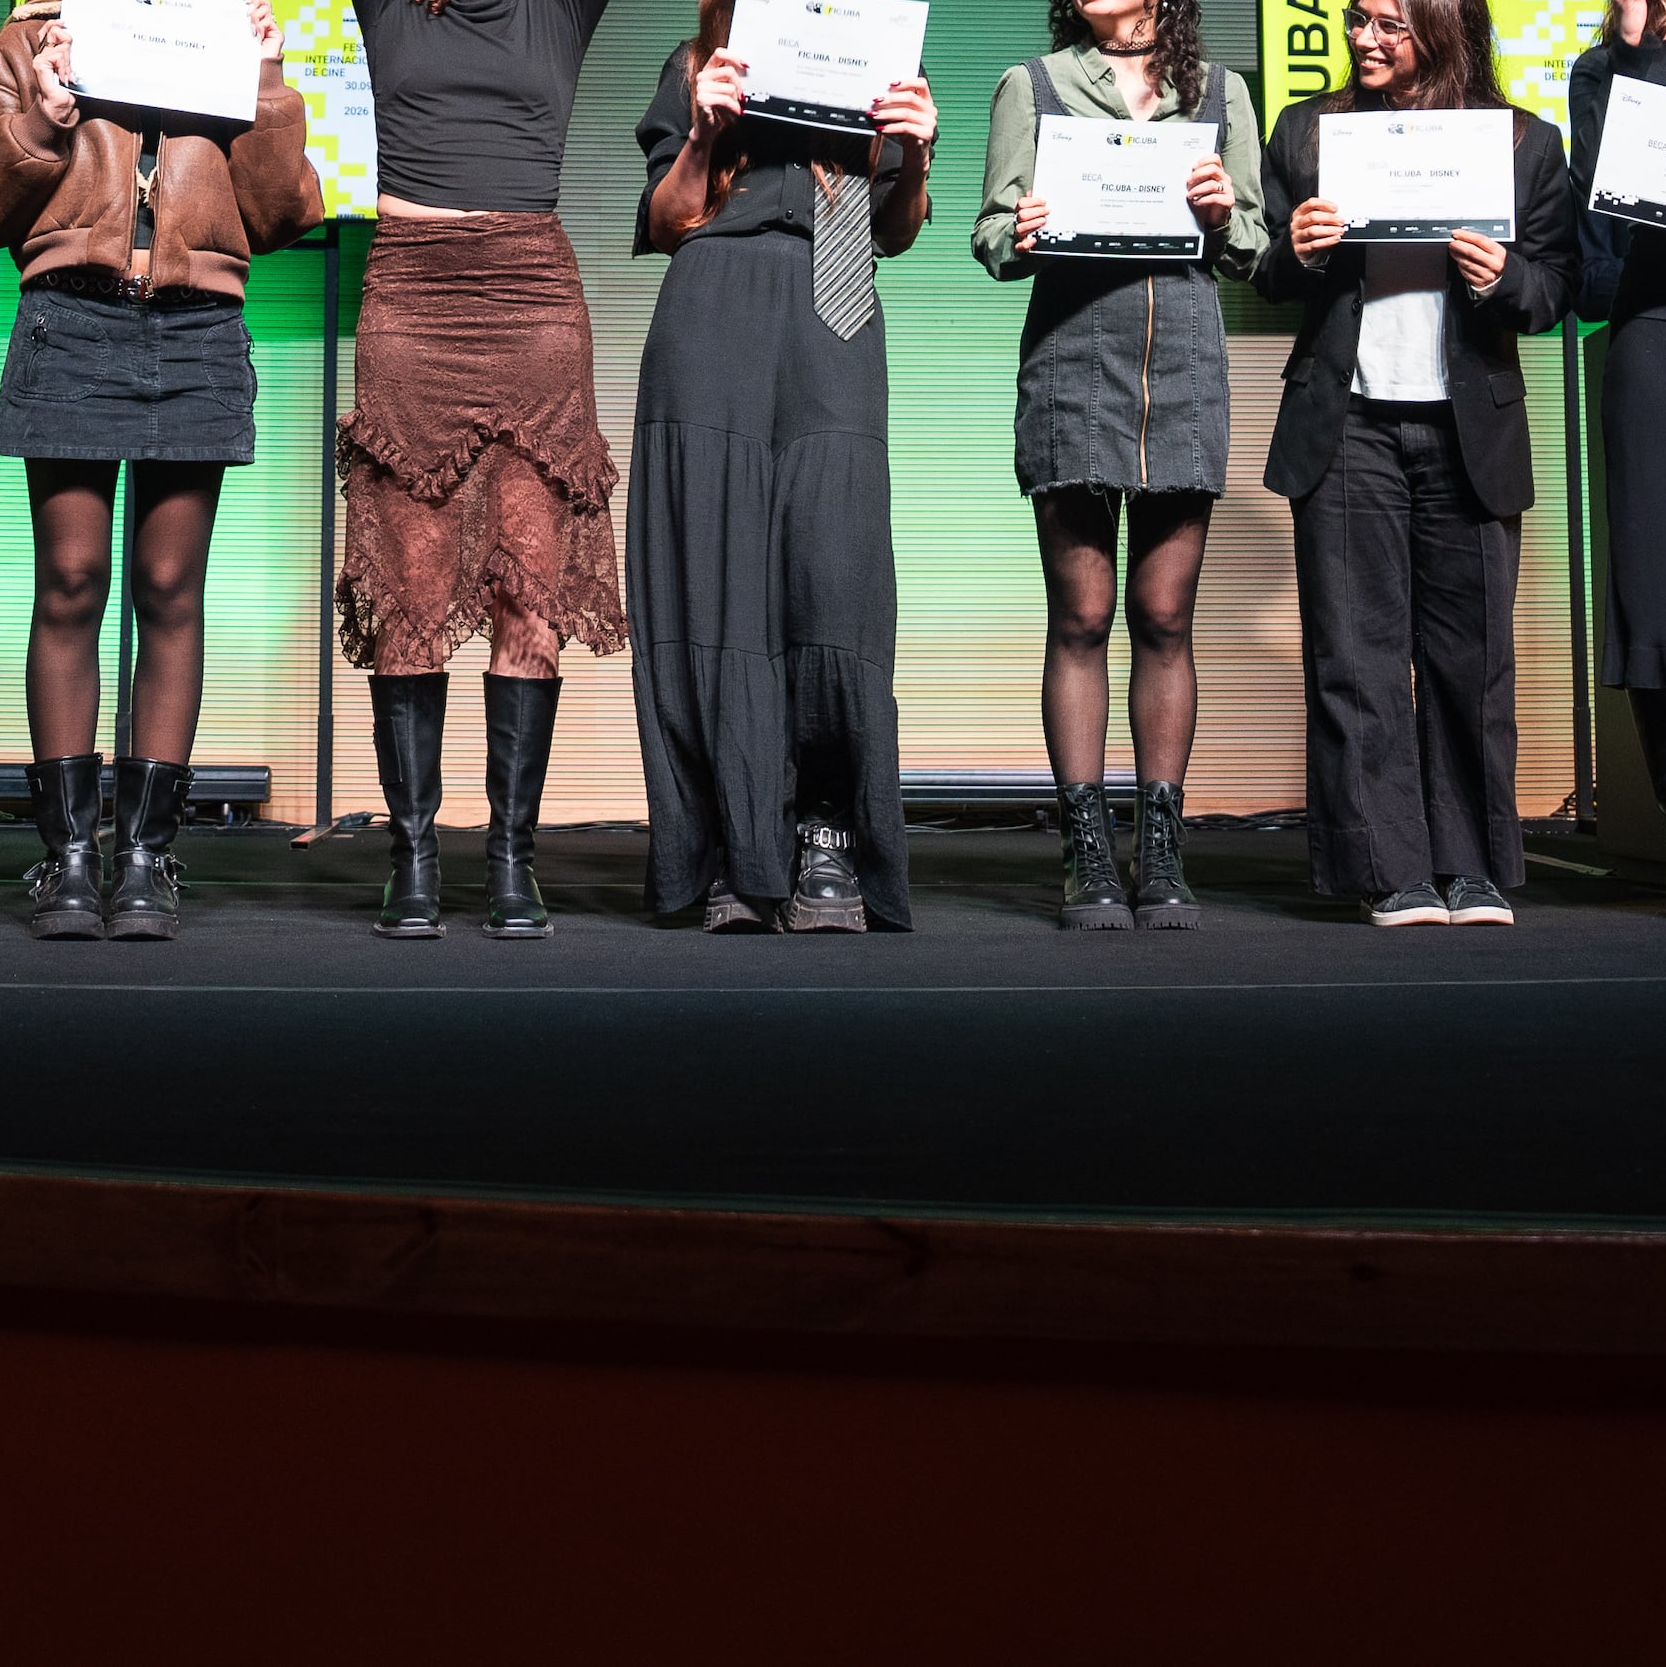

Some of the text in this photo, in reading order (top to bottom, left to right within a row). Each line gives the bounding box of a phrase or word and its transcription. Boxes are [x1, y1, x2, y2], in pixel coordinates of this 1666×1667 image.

[343, 42, 363, 52] FES
[797, 50, 831, 63] FIC.UBA
[838, 56, 869, 68] DISNEY
[305, 67, 346, 77] DE CINE
[1544, 72, 1557, 81] DE
[344, 106, 369, 116] 2026
[1127, 136, 1158, 145] FIC.UBA
[1081, 173, 1103, 182] BECA
[1429, 169, 1461, 178] DISNEY
[1101, 183, 1132, 193] FIC.UBA
[1138, 184, 1166, 194] DISNEY
